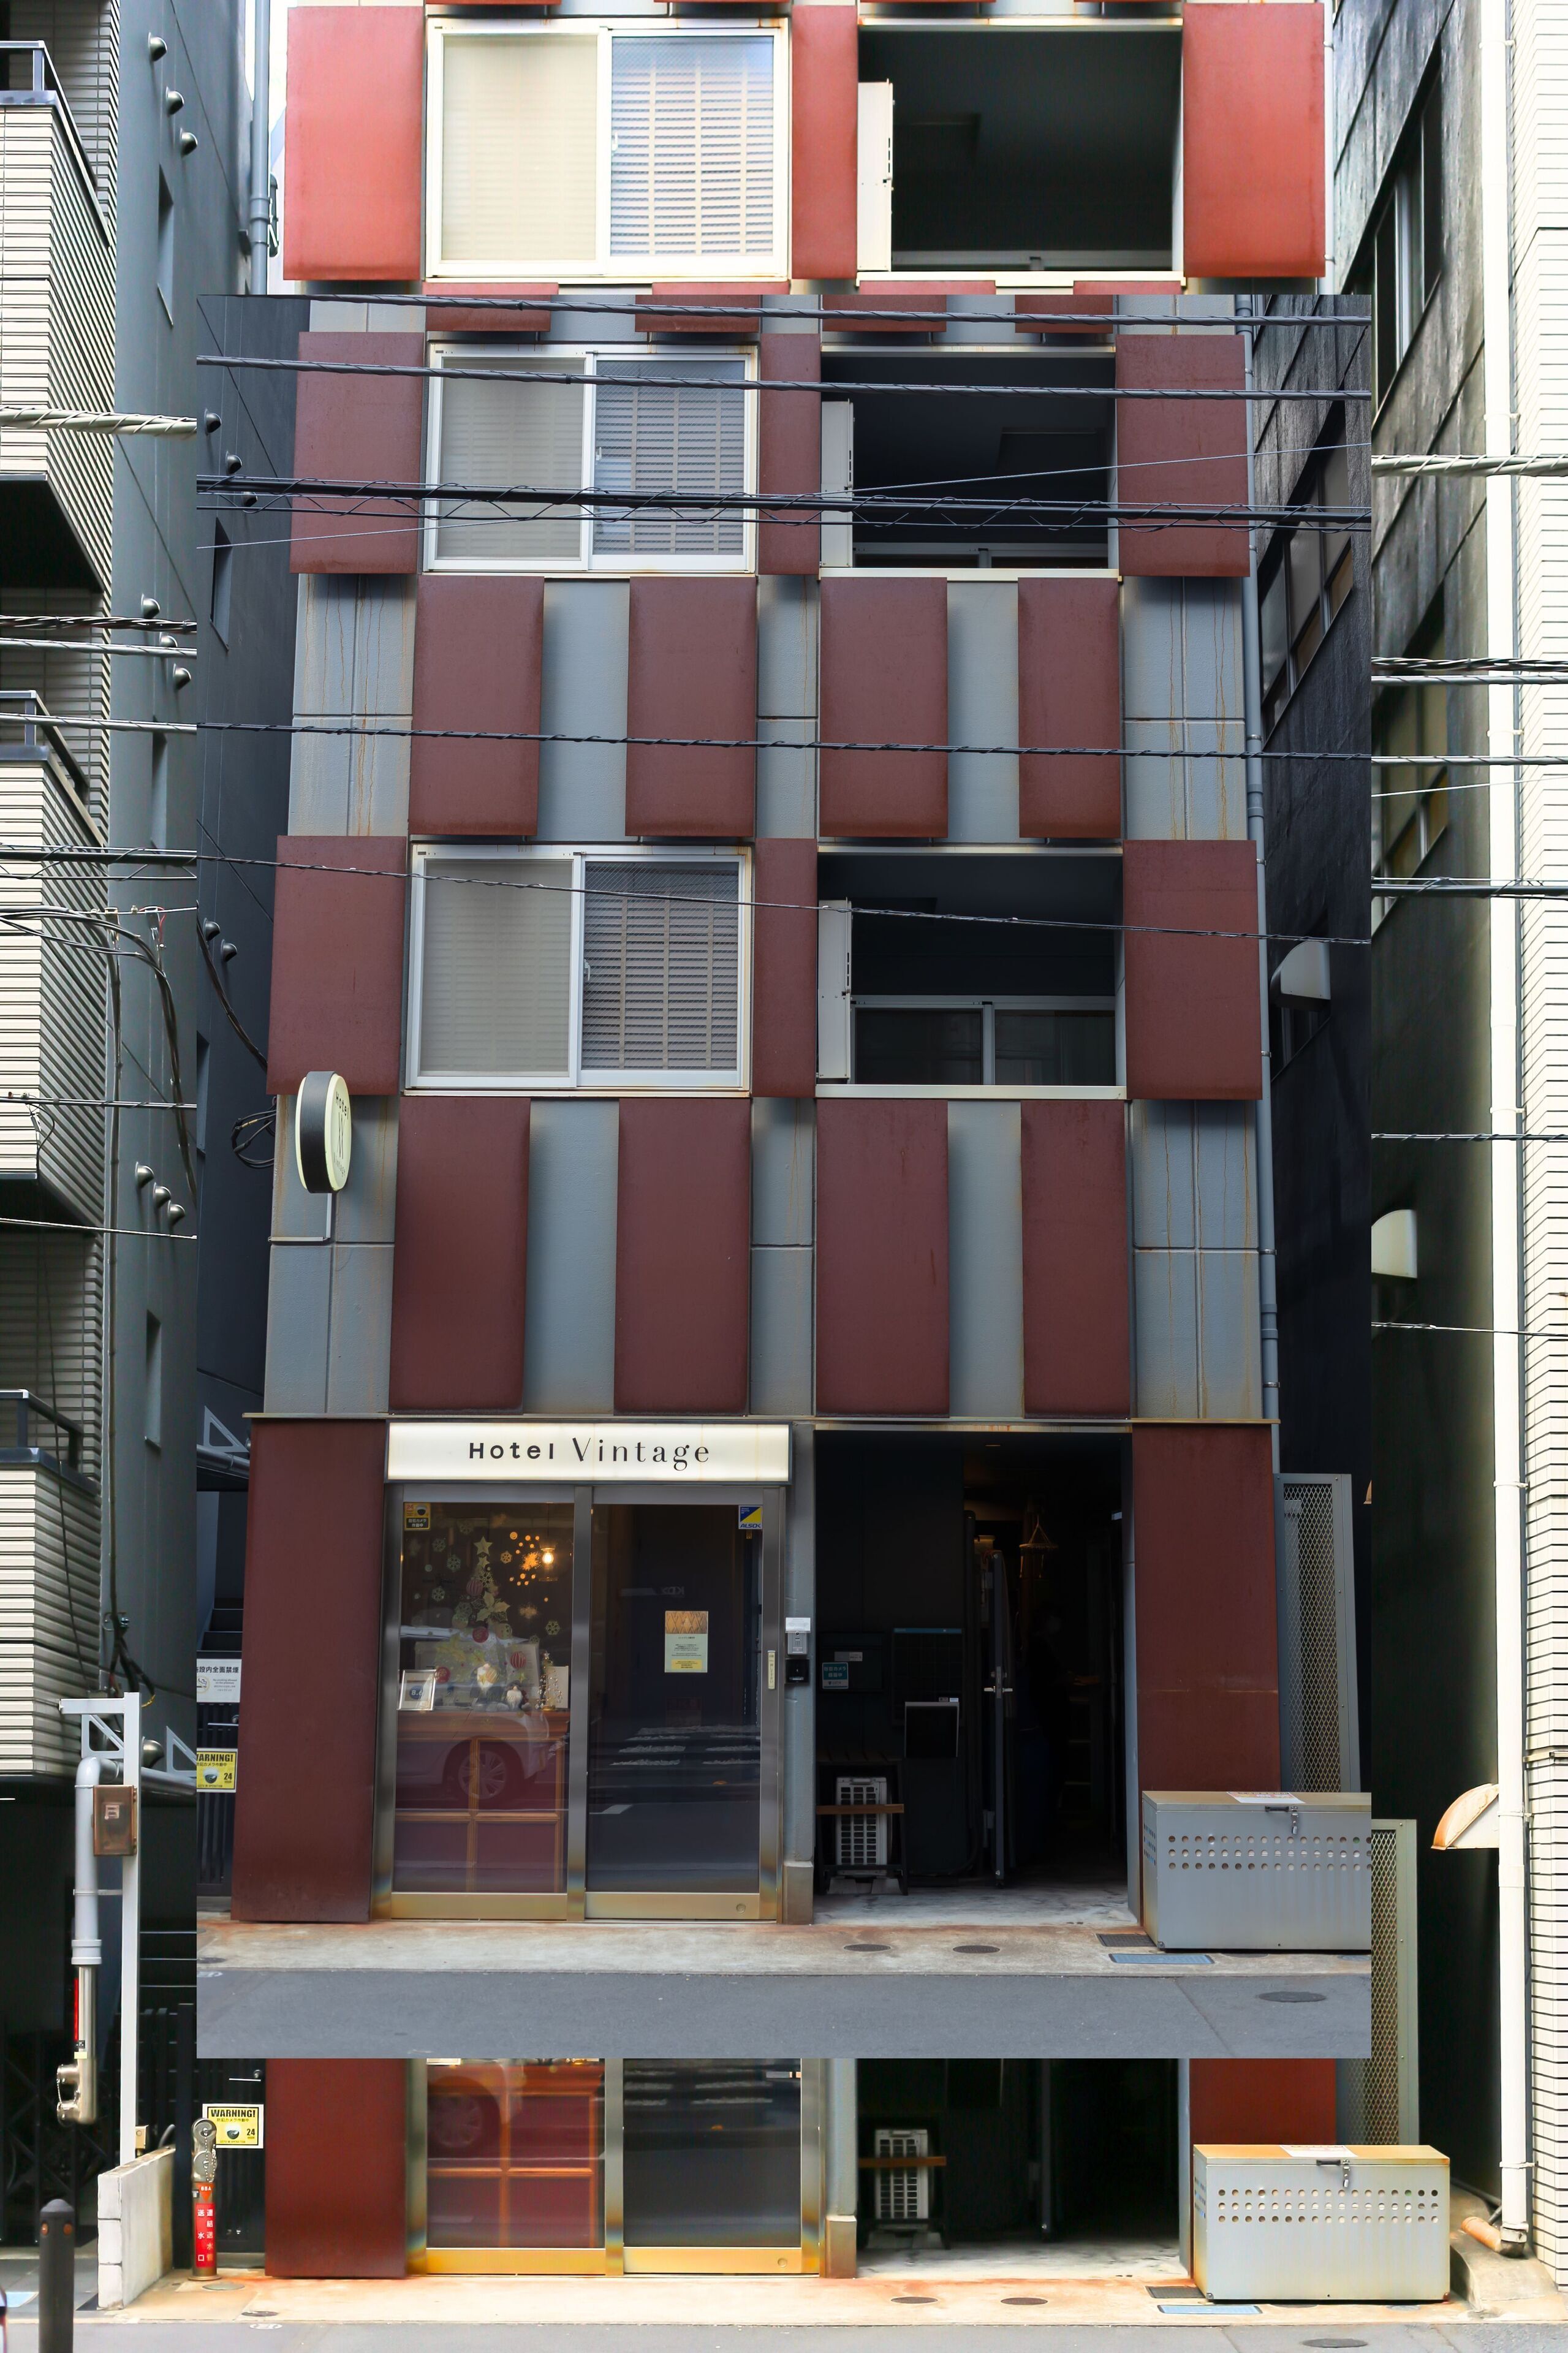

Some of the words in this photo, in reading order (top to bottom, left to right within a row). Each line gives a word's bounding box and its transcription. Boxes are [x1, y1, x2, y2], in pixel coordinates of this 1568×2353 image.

[336, 1091, 349, 1120] Hotel
[469, 1442, 554, 1460] Hotel
[572, 1437, 710, 1471] Vintage
[211, 2109, 256, 2118] WARNING!
